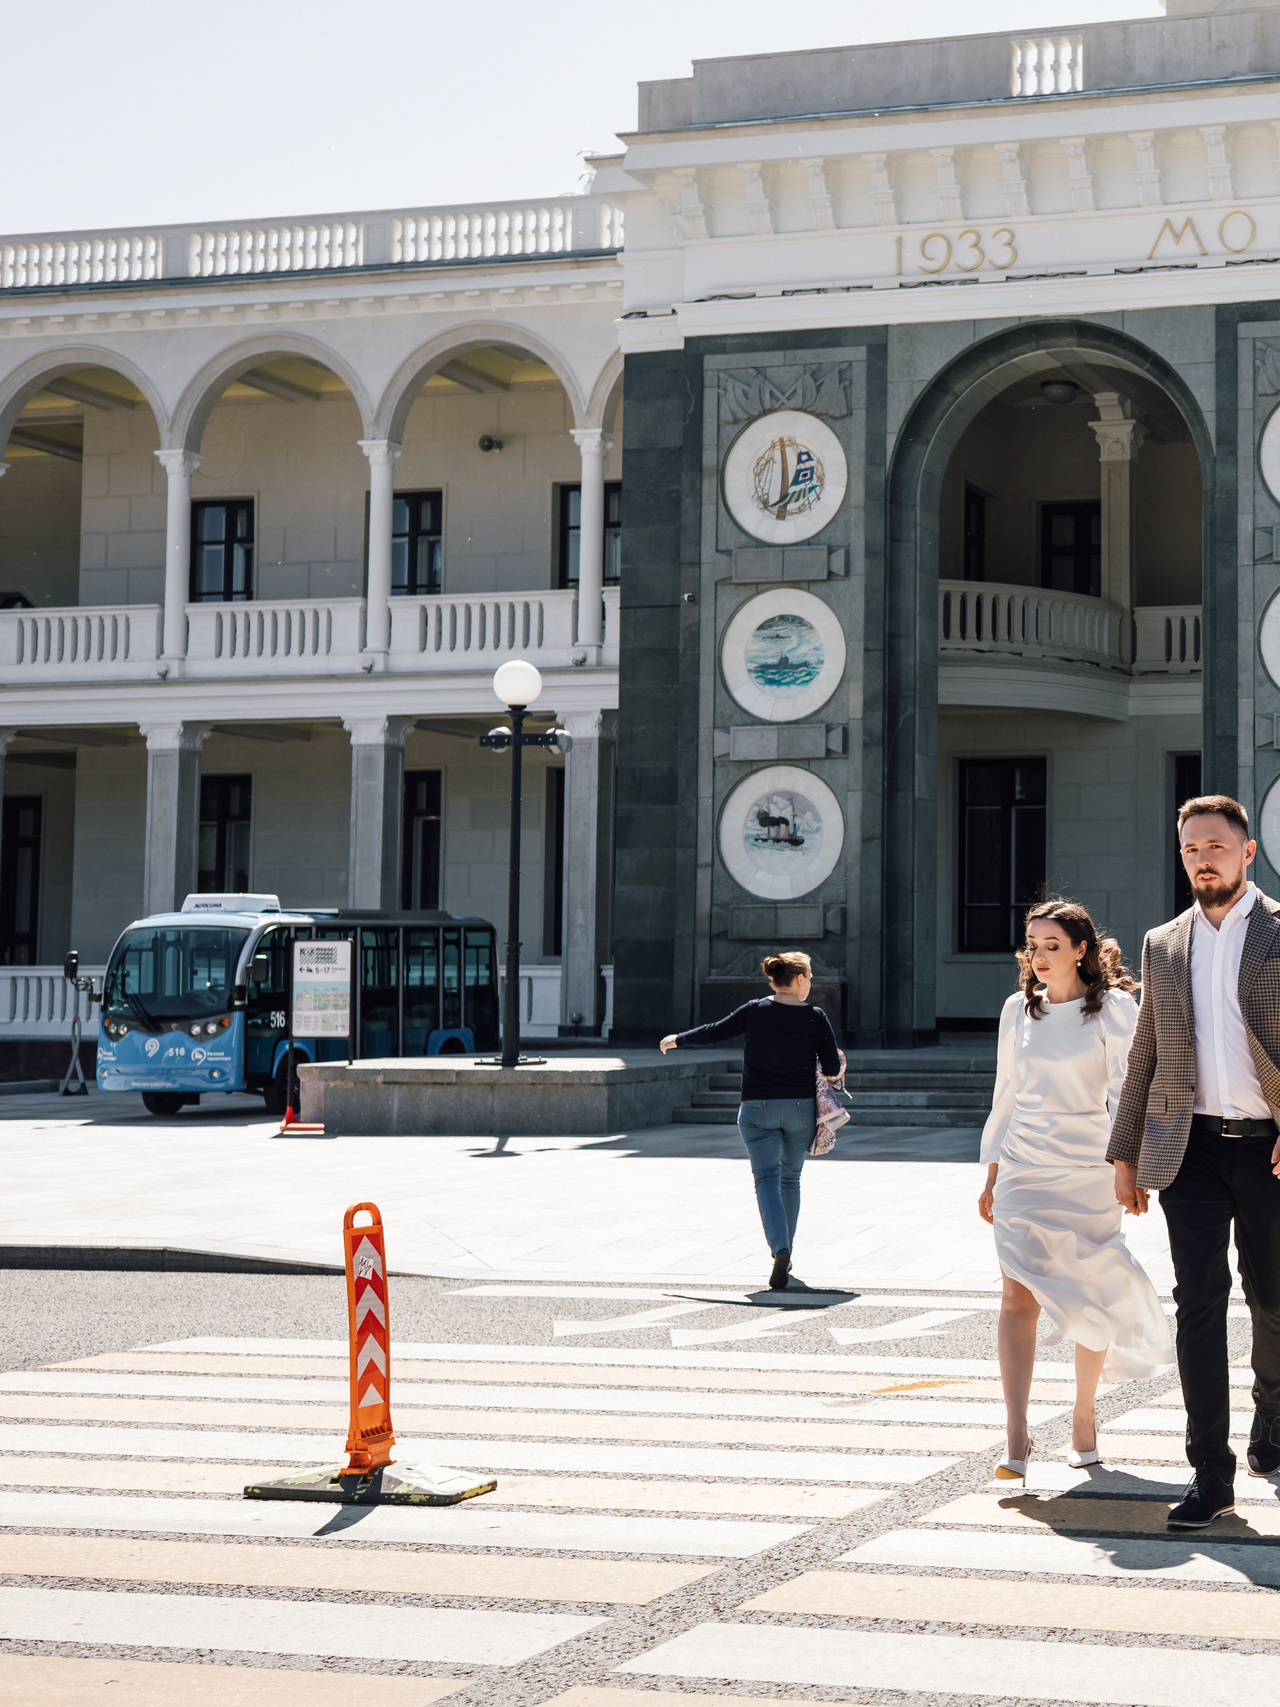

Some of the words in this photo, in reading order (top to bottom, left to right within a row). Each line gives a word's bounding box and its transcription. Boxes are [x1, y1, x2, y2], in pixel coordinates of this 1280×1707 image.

[895, 228, 1019, 275] 1933
[270, 1011, 286, 1028] 516
[168, 1047, 185, 1057] 516
